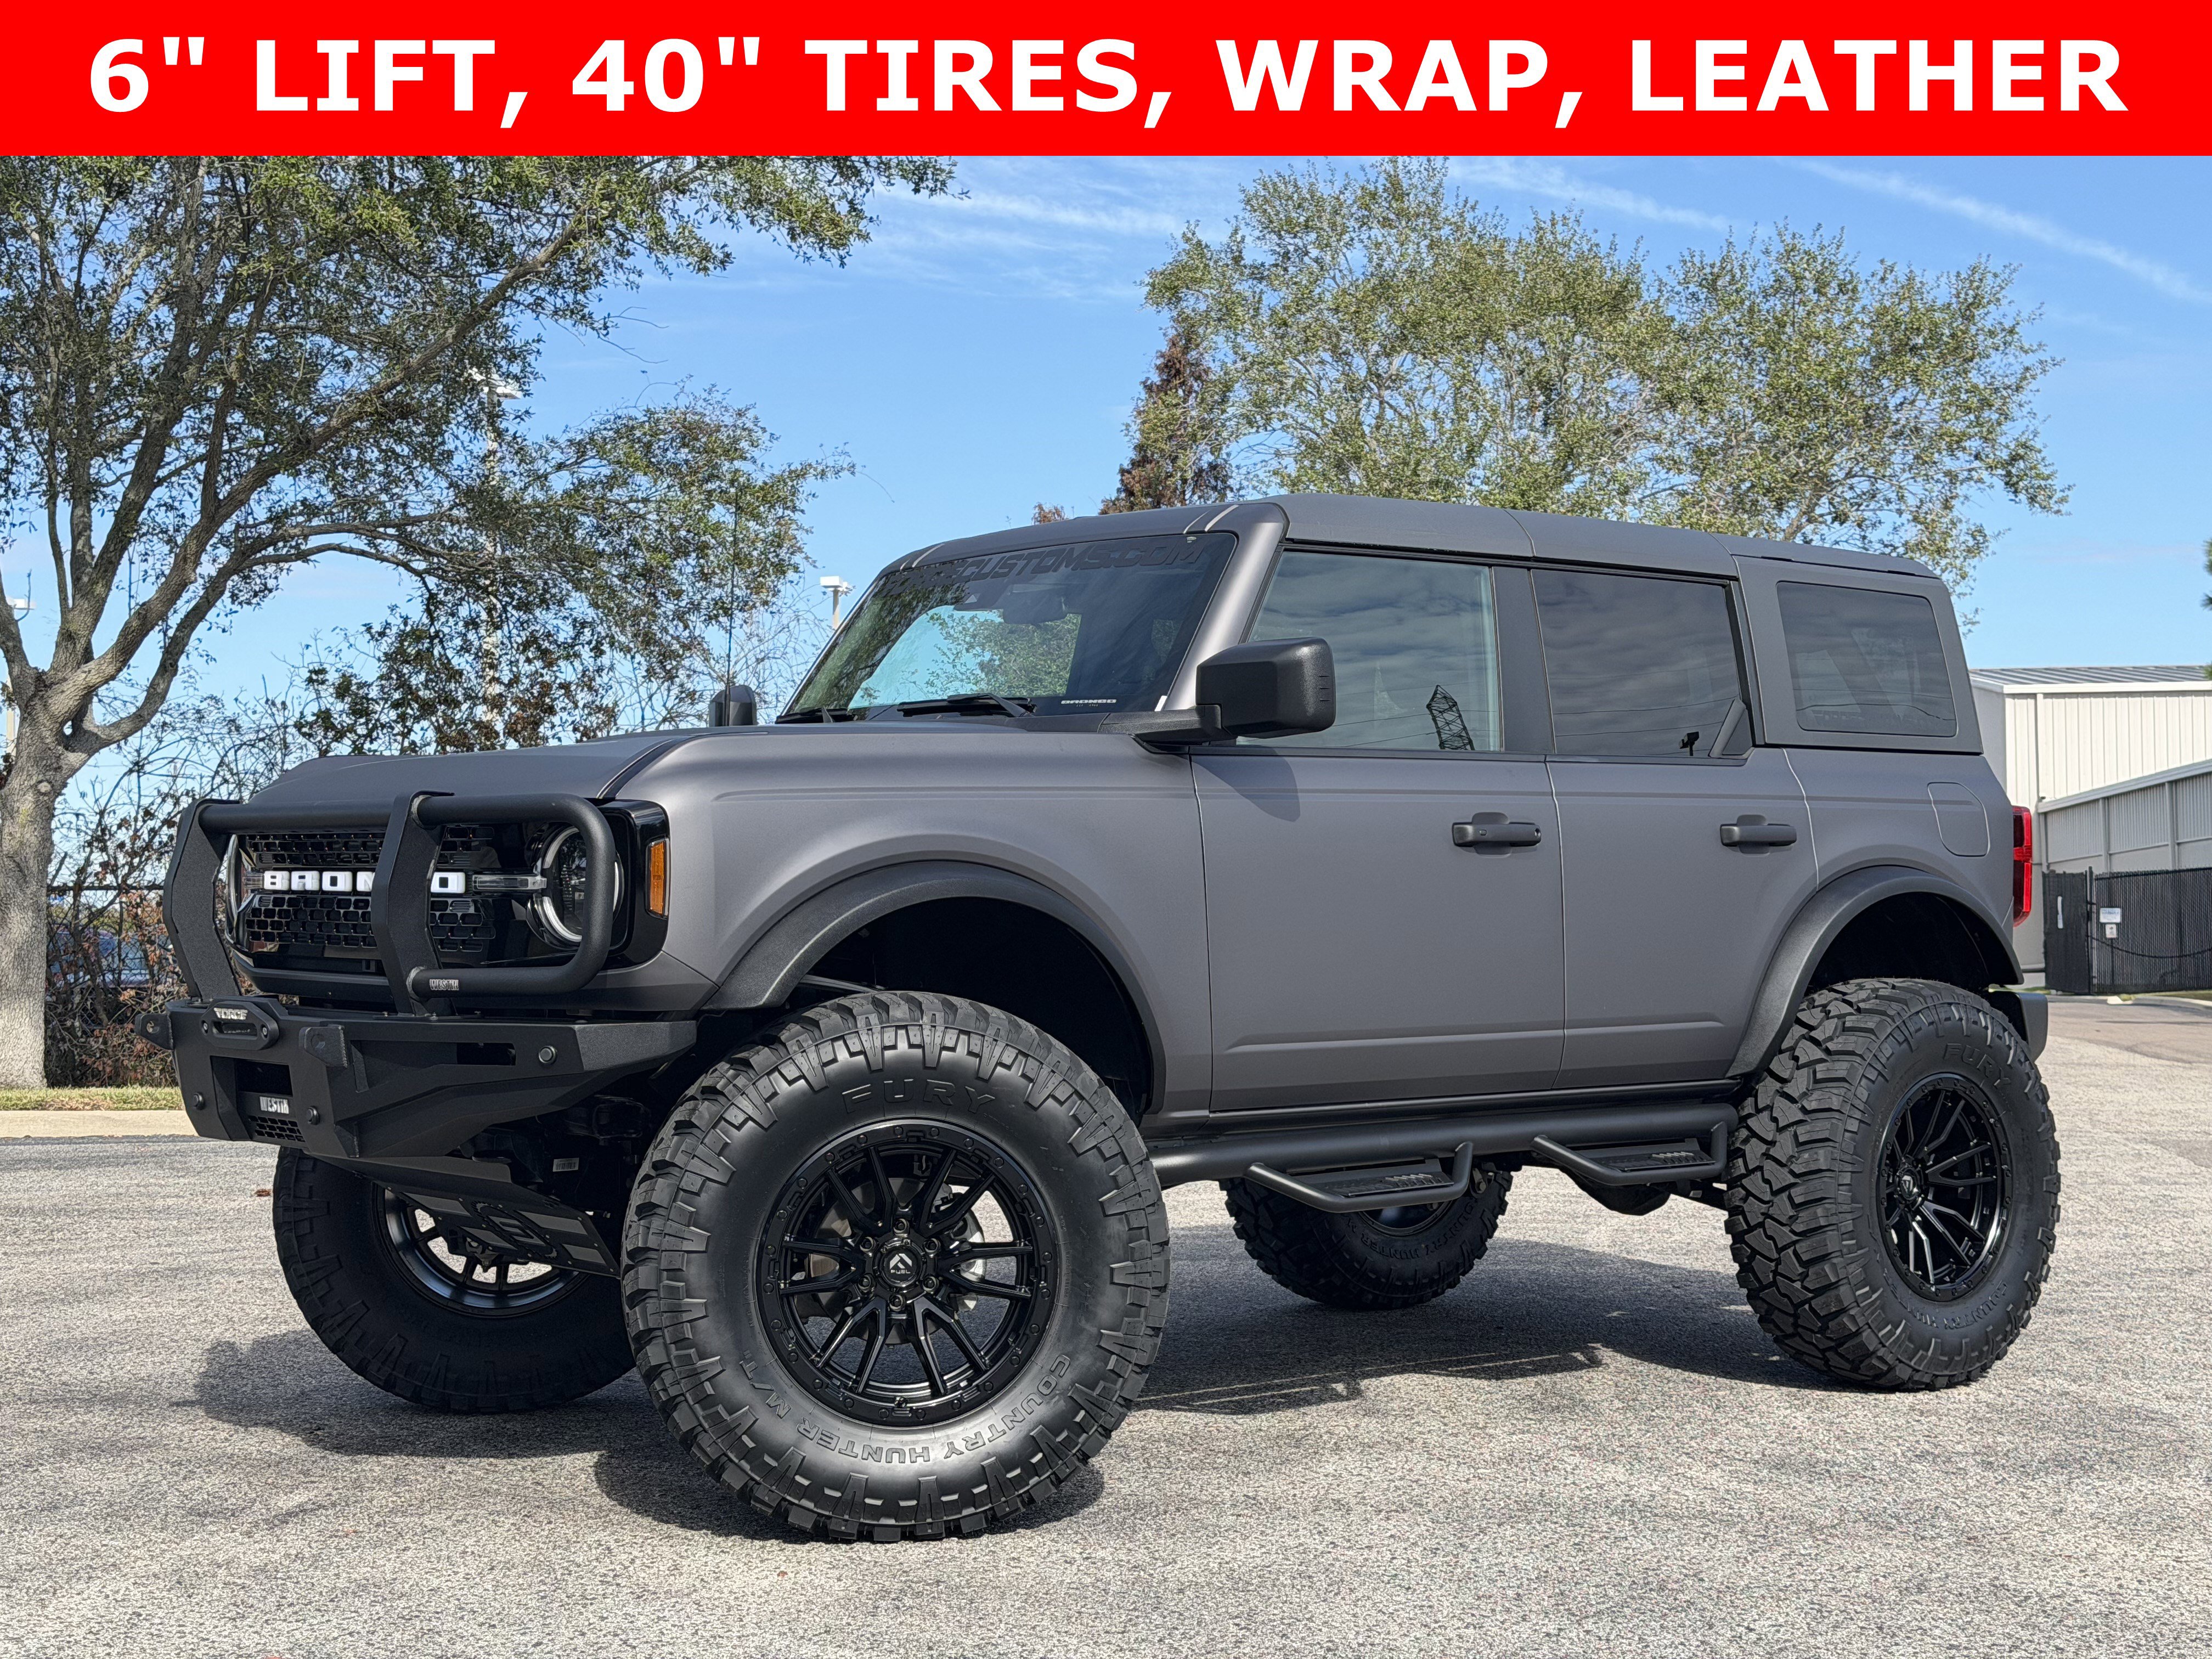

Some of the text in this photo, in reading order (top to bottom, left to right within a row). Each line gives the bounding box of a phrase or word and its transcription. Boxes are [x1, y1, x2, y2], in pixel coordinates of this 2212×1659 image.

[263, 870, 466, 894] BRONO
[840, 1077, 996, 1115] FURY
[739, 1359, 793, 1419] M/T
[943, 1354, 1071, 1460] COUNTRY
[796, 1417, 931, 1465] HUNTER
